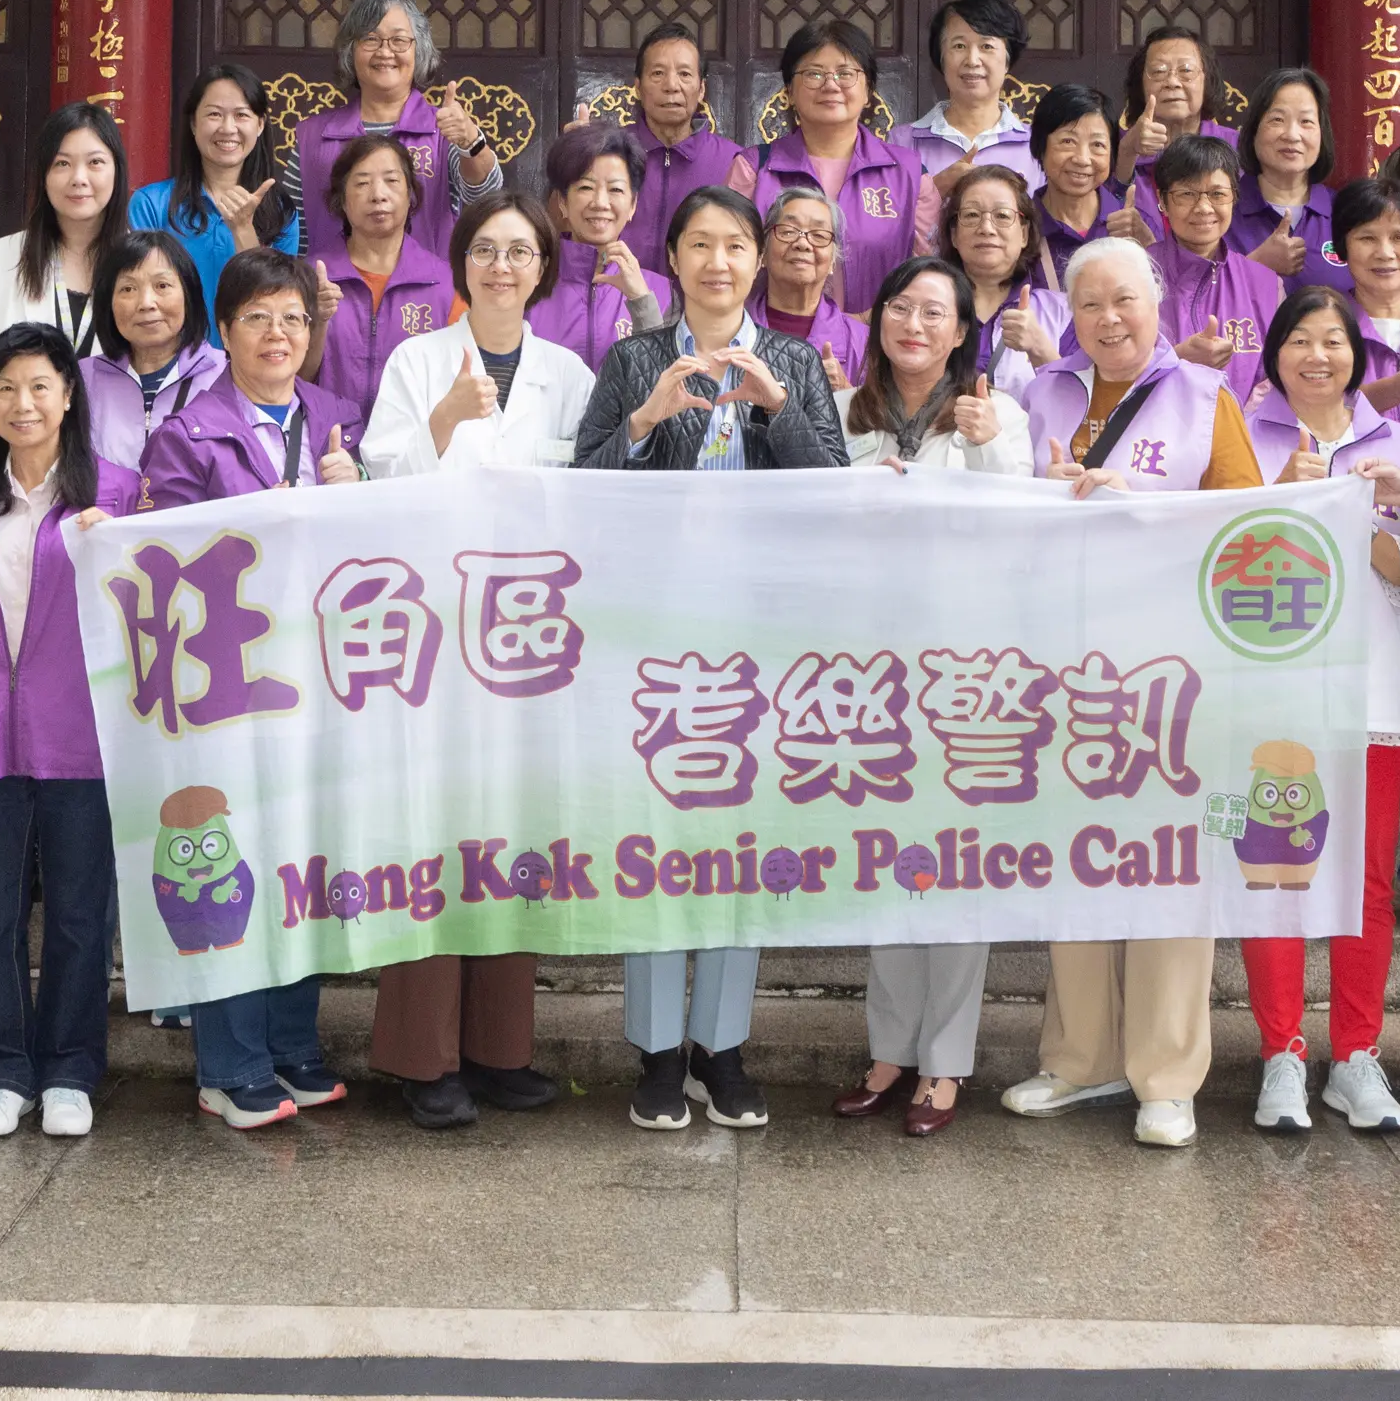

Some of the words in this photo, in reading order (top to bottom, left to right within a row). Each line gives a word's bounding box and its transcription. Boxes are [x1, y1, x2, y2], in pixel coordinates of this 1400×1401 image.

[1130, 438, 1168, 479] 旺
[103, 528, 585, 736] 旺角區
[632, 648, 1200, 810] 耆樂警訊
[615, 833, 836, 898] Senior
[853, 828, 1052, 892] Police
[1070, 825, 1200, 887] Call
